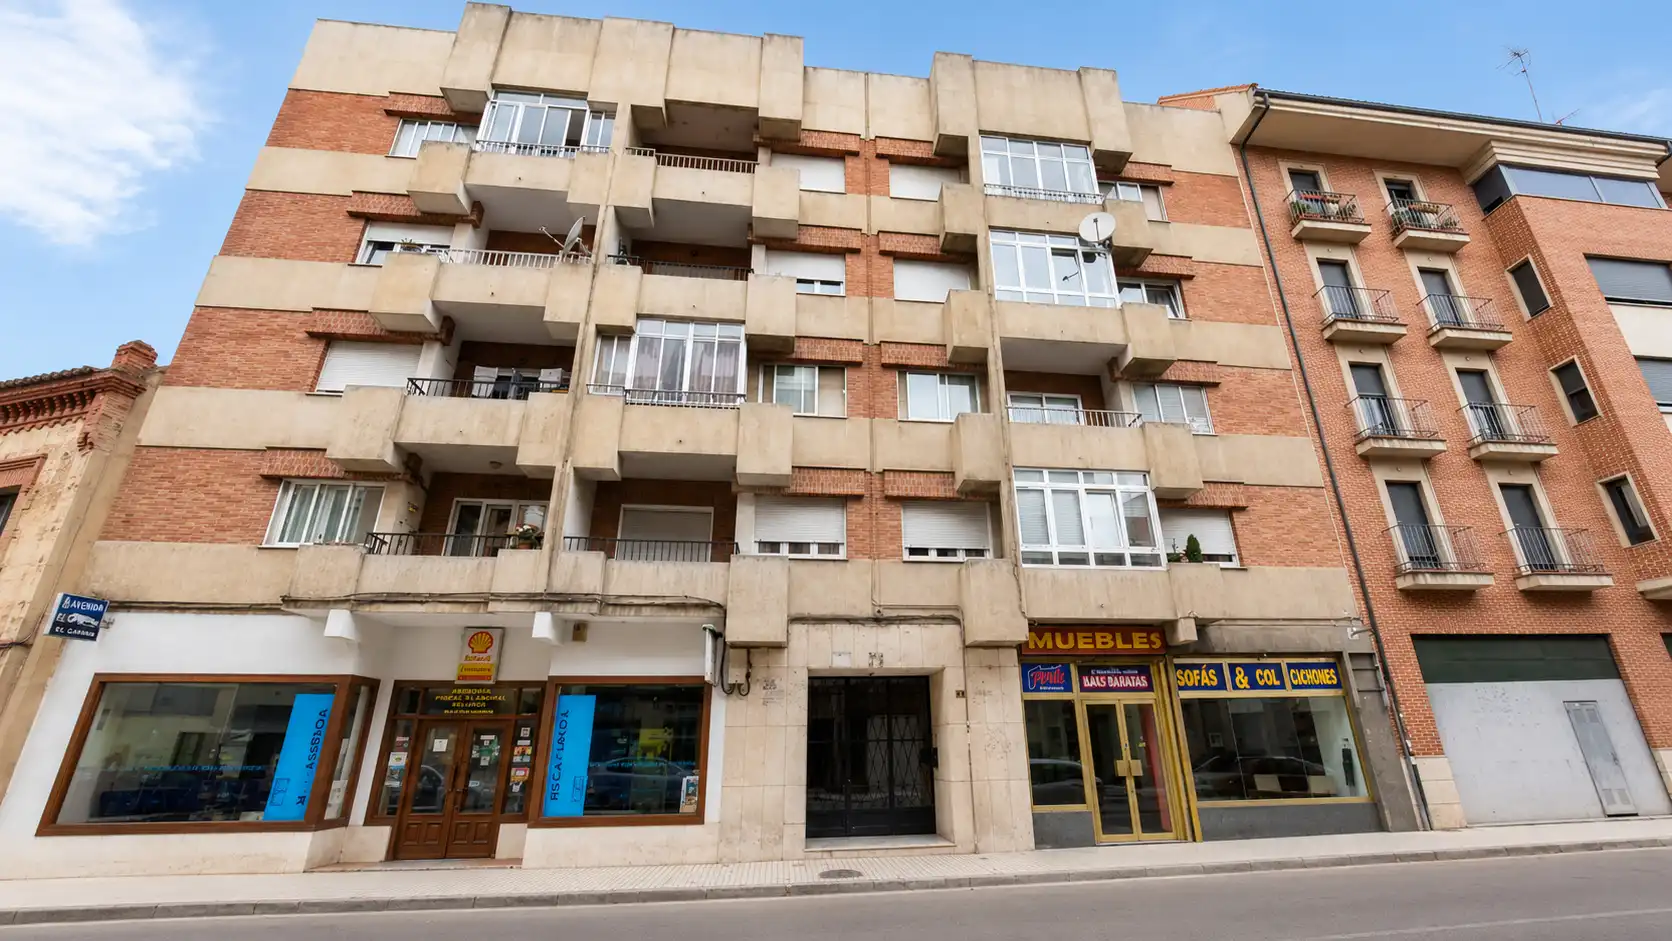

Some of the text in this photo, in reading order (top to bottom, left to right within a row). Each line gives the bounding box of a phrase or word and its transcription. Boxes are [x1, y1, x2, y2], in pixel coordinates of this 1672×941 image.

[1028, 632, 1162, 649] MUEBLES
[1176, 664, 1218, 687] SOFÁS
[1235, 666, 1250, 689] &
[1255, 668, 1281, 686] COL
